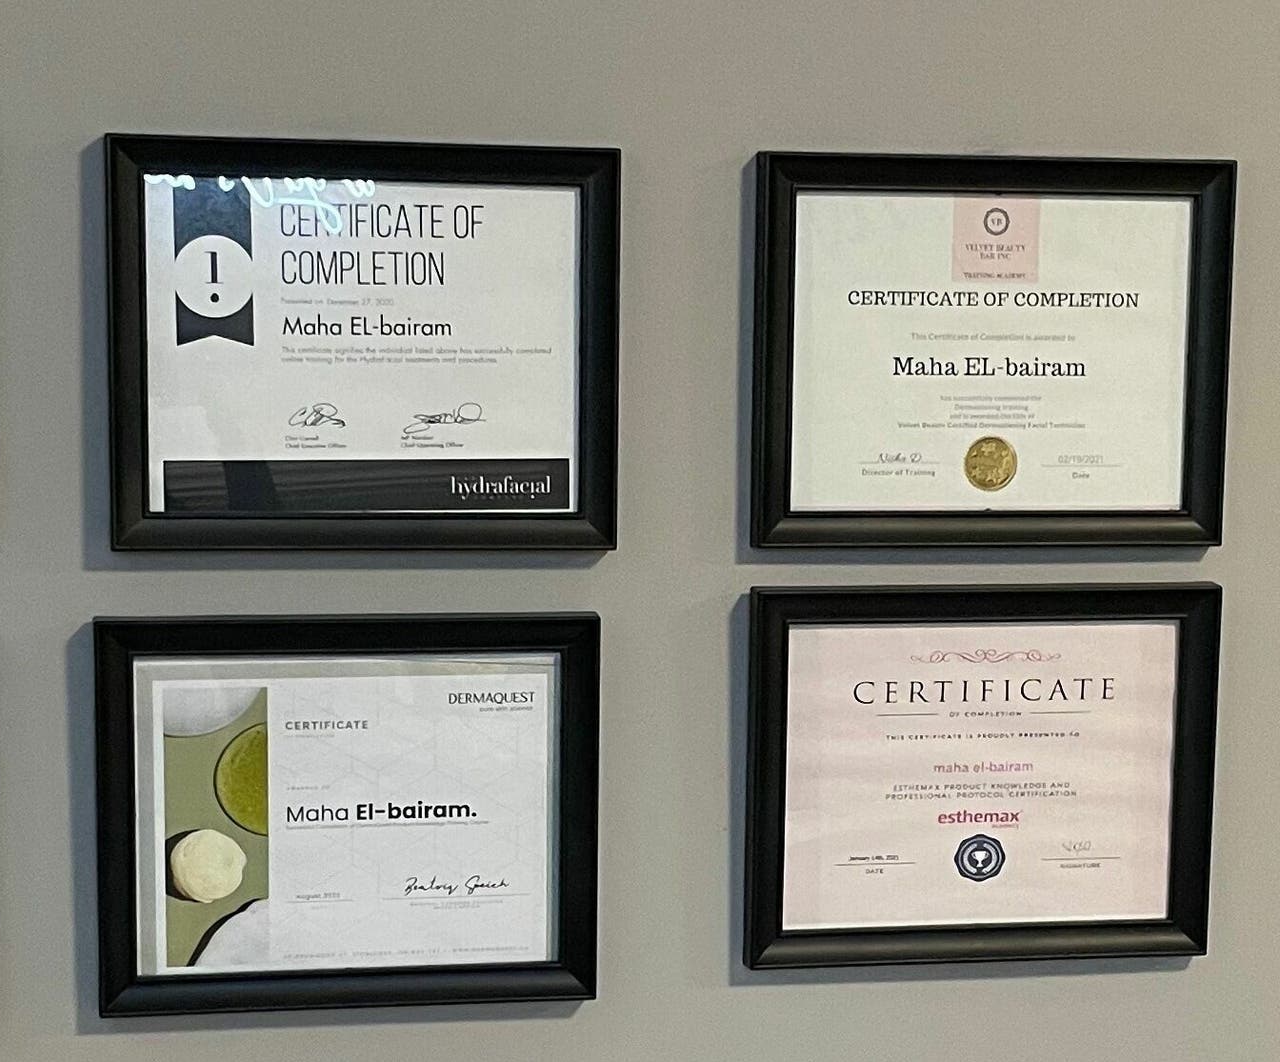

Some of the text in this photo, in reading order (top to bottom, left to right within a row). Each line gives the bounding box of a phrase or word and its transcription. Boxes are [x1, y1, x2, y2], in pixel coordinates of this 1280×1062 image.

[280, 203, 445, 239] CERTIFICATE
[453, 205, 484, 239] OF
[281, 250, 445, 286] COMPLETION
[847, 290, 1140, 308] CERTIFICATE OF COMPLETION
[282, 314, 452, 336] Maha EL-bairam
[892, 357, 1086, 377] Maha EL-bairam
[451, 475, 551, 500] hydrafacial
[448, 691, 535, 705] DERMAQUEST
[853, 677, 1115, 705] CERTIFICATE
[284, 720, 369, 731] CERTIFICATE
[908, 733, 963, 741] CERTIFICATE
[933, 761, 1033, 774] maha el-bairam
[893, 781, 1070, 792] ESTHEMAX PRODUCT KNOWLEDGE AND
[957, 791, 1004, 799] PROTOCOL
[1009, 790, 1077, 799] CERTIFICATION
[286, 800, 477, 822] Maha El-bairam.
[937, 809, 1020, 824] esthemax
